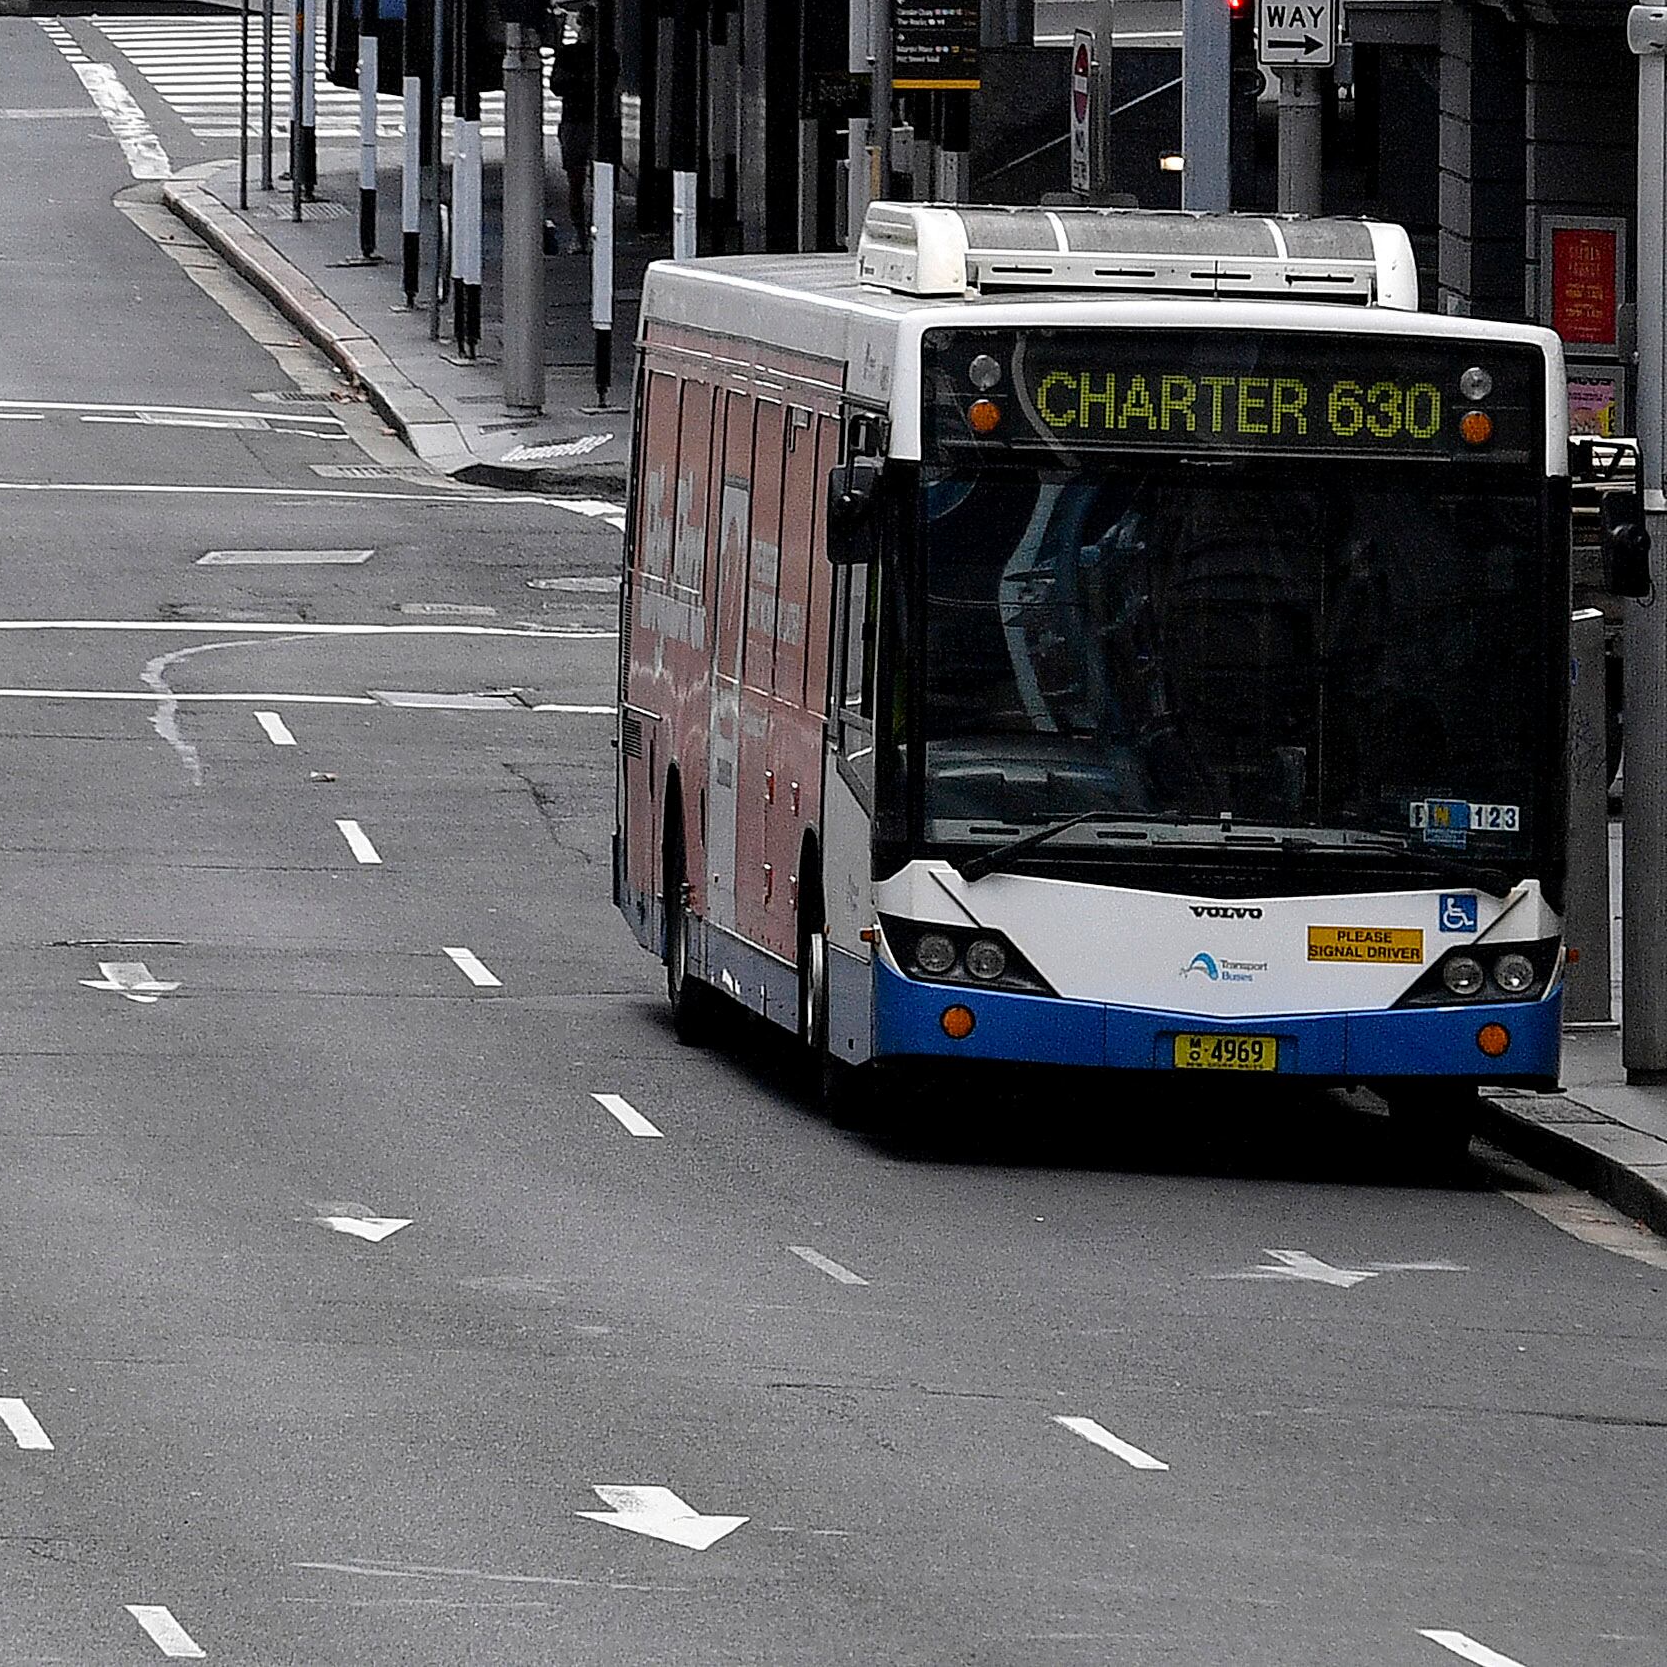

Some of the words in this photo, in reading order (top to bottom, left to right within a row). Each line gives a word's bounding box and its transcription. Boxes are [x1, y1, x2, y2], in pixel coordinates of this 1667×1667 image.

[1267, 5, 1324, 28] WAY
[1037, 371, 1308, 434] CHARTER
[1328, 380, 1441, 438] 630
[1189, 906, 1263, 919] VOLVO
[1336, 930, 1392, 944] PLEASE
[1309, 944, 1362, 958] SIGNAL
[1367, 946, 1420, 960] DRIVER
[1221, 959, 1267, 972] Transport
[1222, 971, 1253, 982] Buses
[1210, 1039, 1264, 1063] 4969
